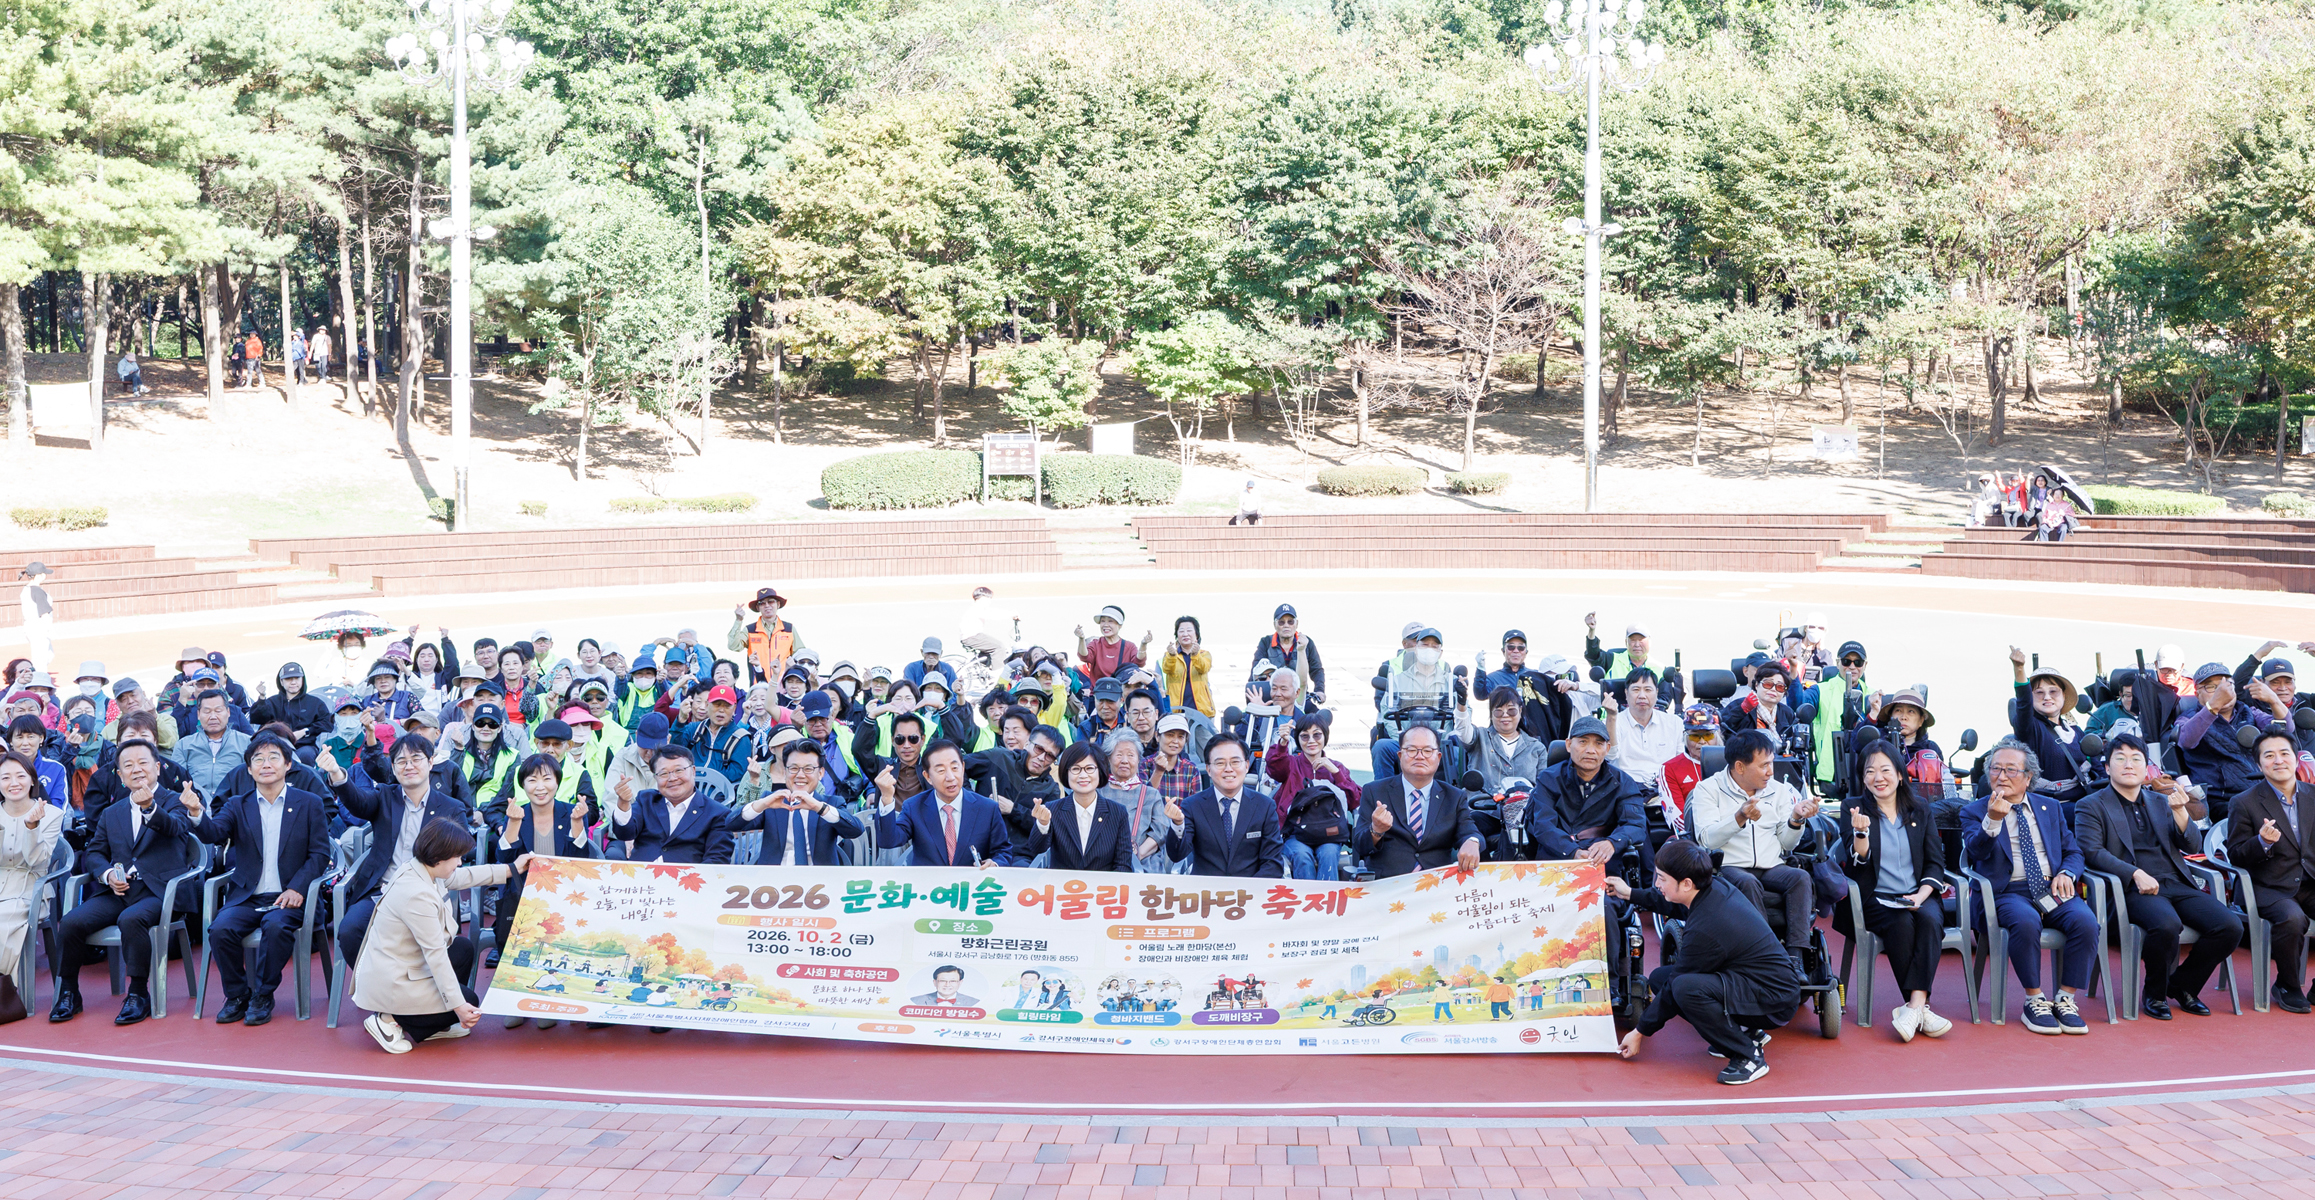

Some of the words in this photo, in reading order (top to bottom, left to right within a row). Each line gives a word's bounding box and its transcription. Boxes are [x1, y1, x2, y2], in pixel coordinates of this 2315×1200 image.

[598, 885, 656, 895] 함께하는
[721, 884, 830, 910] 2026
[840, 877, 1008, 916] 문화·예술
[1017, 879, 1129, 921] 어울림
[1139, 884, 1253, 921] 한마당
[1261, 885, 1348, 920] 축제
[1455, 889, 1494, 903] 다름이
[593, 898, 617, 911] 오늘,
[639, 897, 676, 907] 빛나는
[1457, 902, 1504, 918] 어울림이
[1509, 897, 1531, 909] 되는
[621, 908, 655, 921] 내일!
[1468, 913, 1522, 930] 아름다운
[1528, 903, 1555, 919] 축제
[760, 917, 787, 927] 행사
[792, 917, 819, 928] 일시
[952, 922, 979, 932] 장소
[747, 930, 791, 941] 2026.
[797, 930, 824, 943] 10.
[830, 932, 842, 944] 2
[848, 934, 875, 946] (금)
[1143, 927, 1195, 938] 프로그램
[961, 937, 1048, 951] 방화근린공원
[1139, 943, 1165, 951] 어울림
[1167, 943, 1185, 951] 노래
[1187, 943, 1237, 951] 한마당(본선)
[1311, 939, 1319, 947] 및
[747, 943, 789, 955] 13:00
[809, 946, 852, 958] 18:00
[1330, 947, 1339, 955] 및
[1341, 946, 1360, 954] 세척
[954, 951, 978, 959] 강서구
[980, 952, 1012, 960] 금낭화로
[1014, 953, 1028, 961] 176
[1030, 953, 1057, 962] (방화동
[1059, 954, 1079, 962] 855)
[1138, 954, 1172, 963] 장애인과
[1175, 954, 1209, 962] 비장애인
[1211, 953, 1229, 961] 체육
[1231, 953, 1249, 961] 체험
[804, 967, 827, 977] 사회
[829, 969, 840, 978] 및
[843, 969, 888, 980] 축하공연
[812, 985, 839, 994] 문화로
[842, 986, 863, 994] 하나
[866, 986, 882, 994] 되는
[818, 997, 848, 1005] 따뜻한
[851, 997, 873, 1005] 세상
[904, 1007, 943, 1017] 코미디언
[946, 1008, 980, 1018] 방일수
[1017, 1011, 1062, 1022] 힐링타임
[1207, 1012, 1264, 1022] 도깨비장구
[1110, 1014, 1165, 1023] 청바지밴드
[952, 1030, 1002, 1039] 서울특별시
[1444, 1036, 1498, 1045] 서울강서방송
